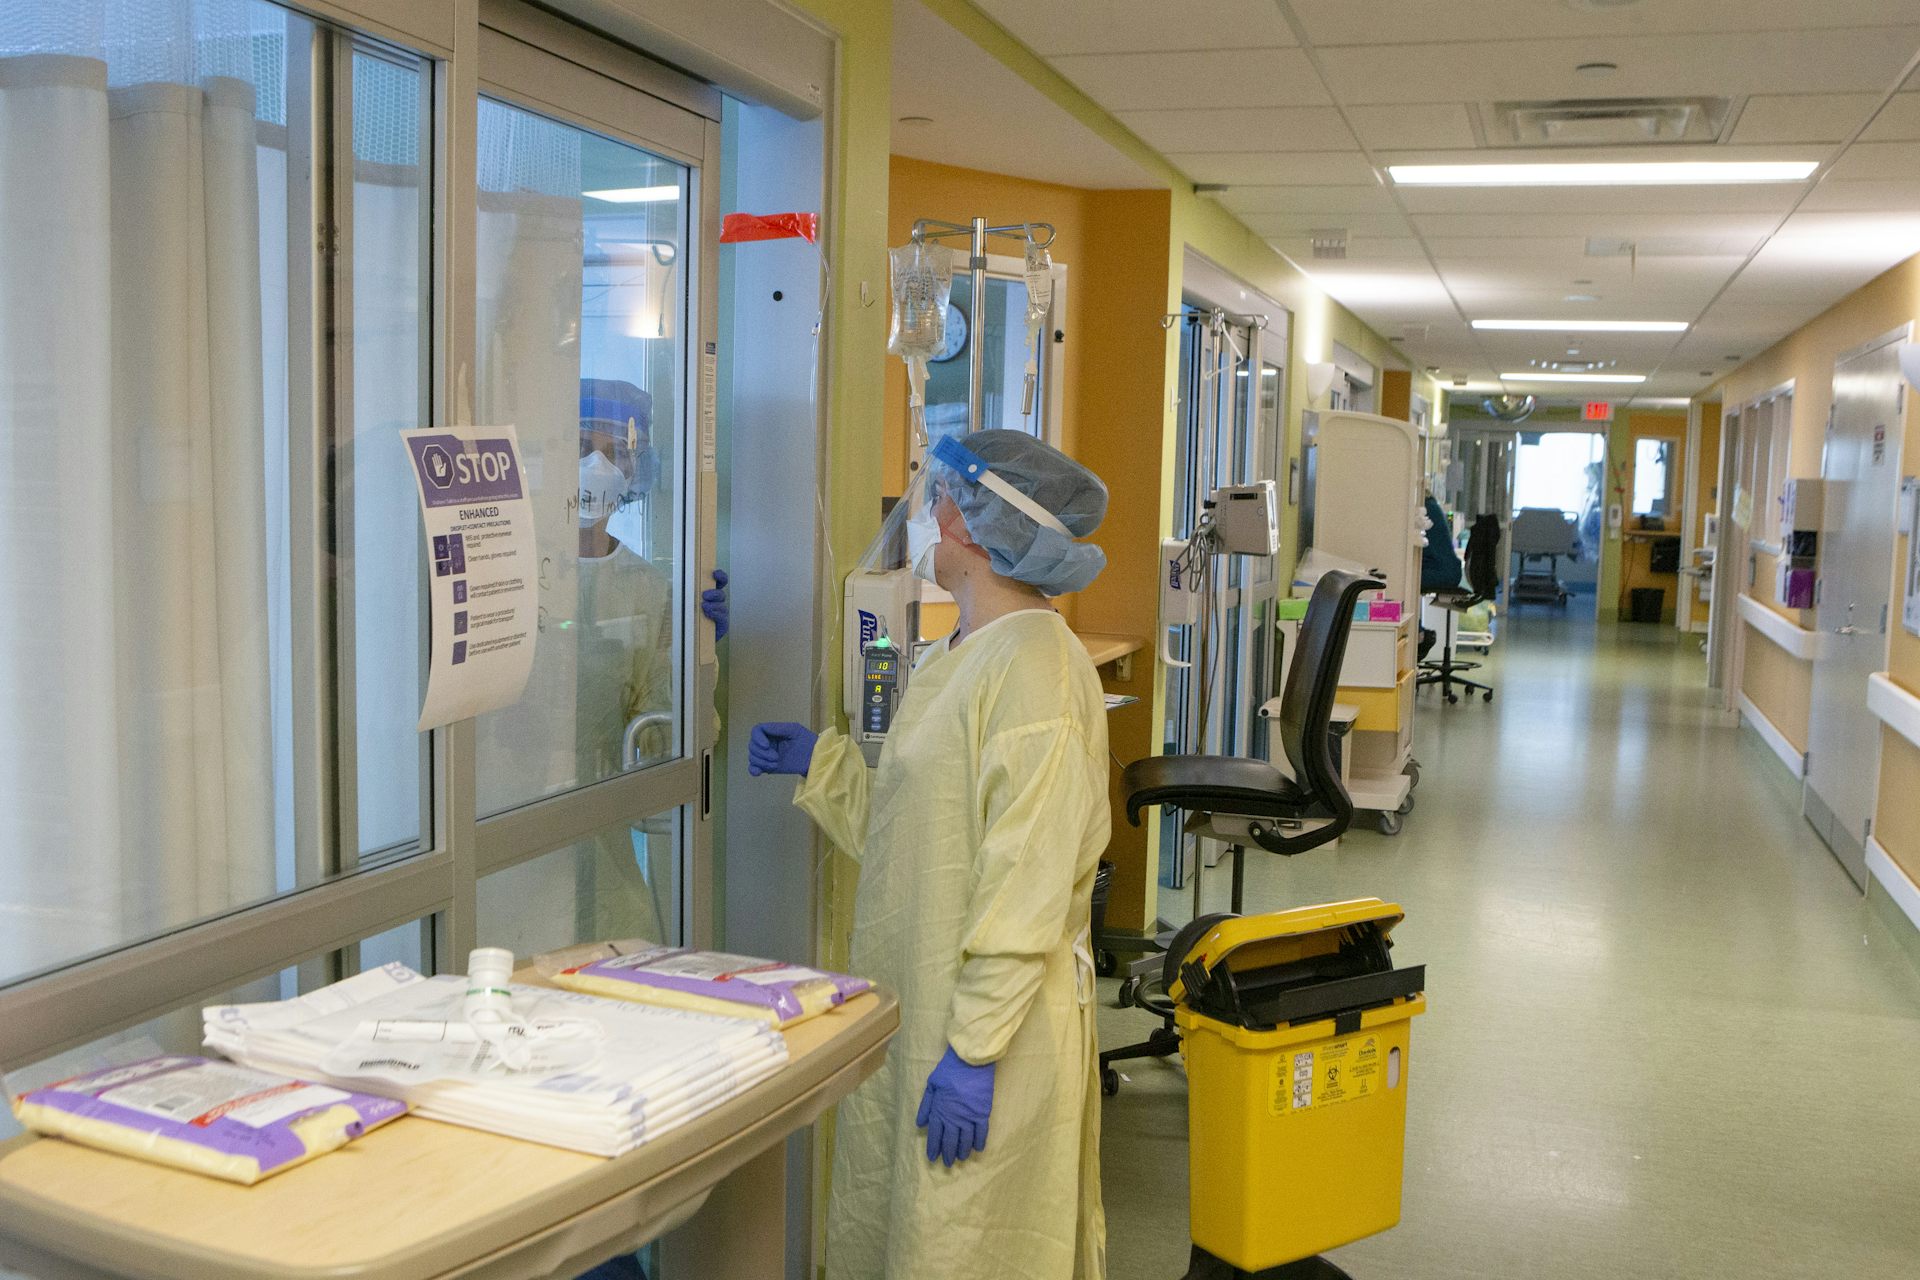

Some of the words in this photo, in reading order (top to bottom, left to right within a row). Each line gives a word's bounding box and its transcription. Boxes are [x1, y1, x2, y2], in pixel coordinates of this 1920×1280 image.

[1586, 402, 1608, 419] EXIT
[455, 452, 510, 484] STOP
[459, 507, 499, 520] ENHANCED
[879, 662, 889, 670] 10
